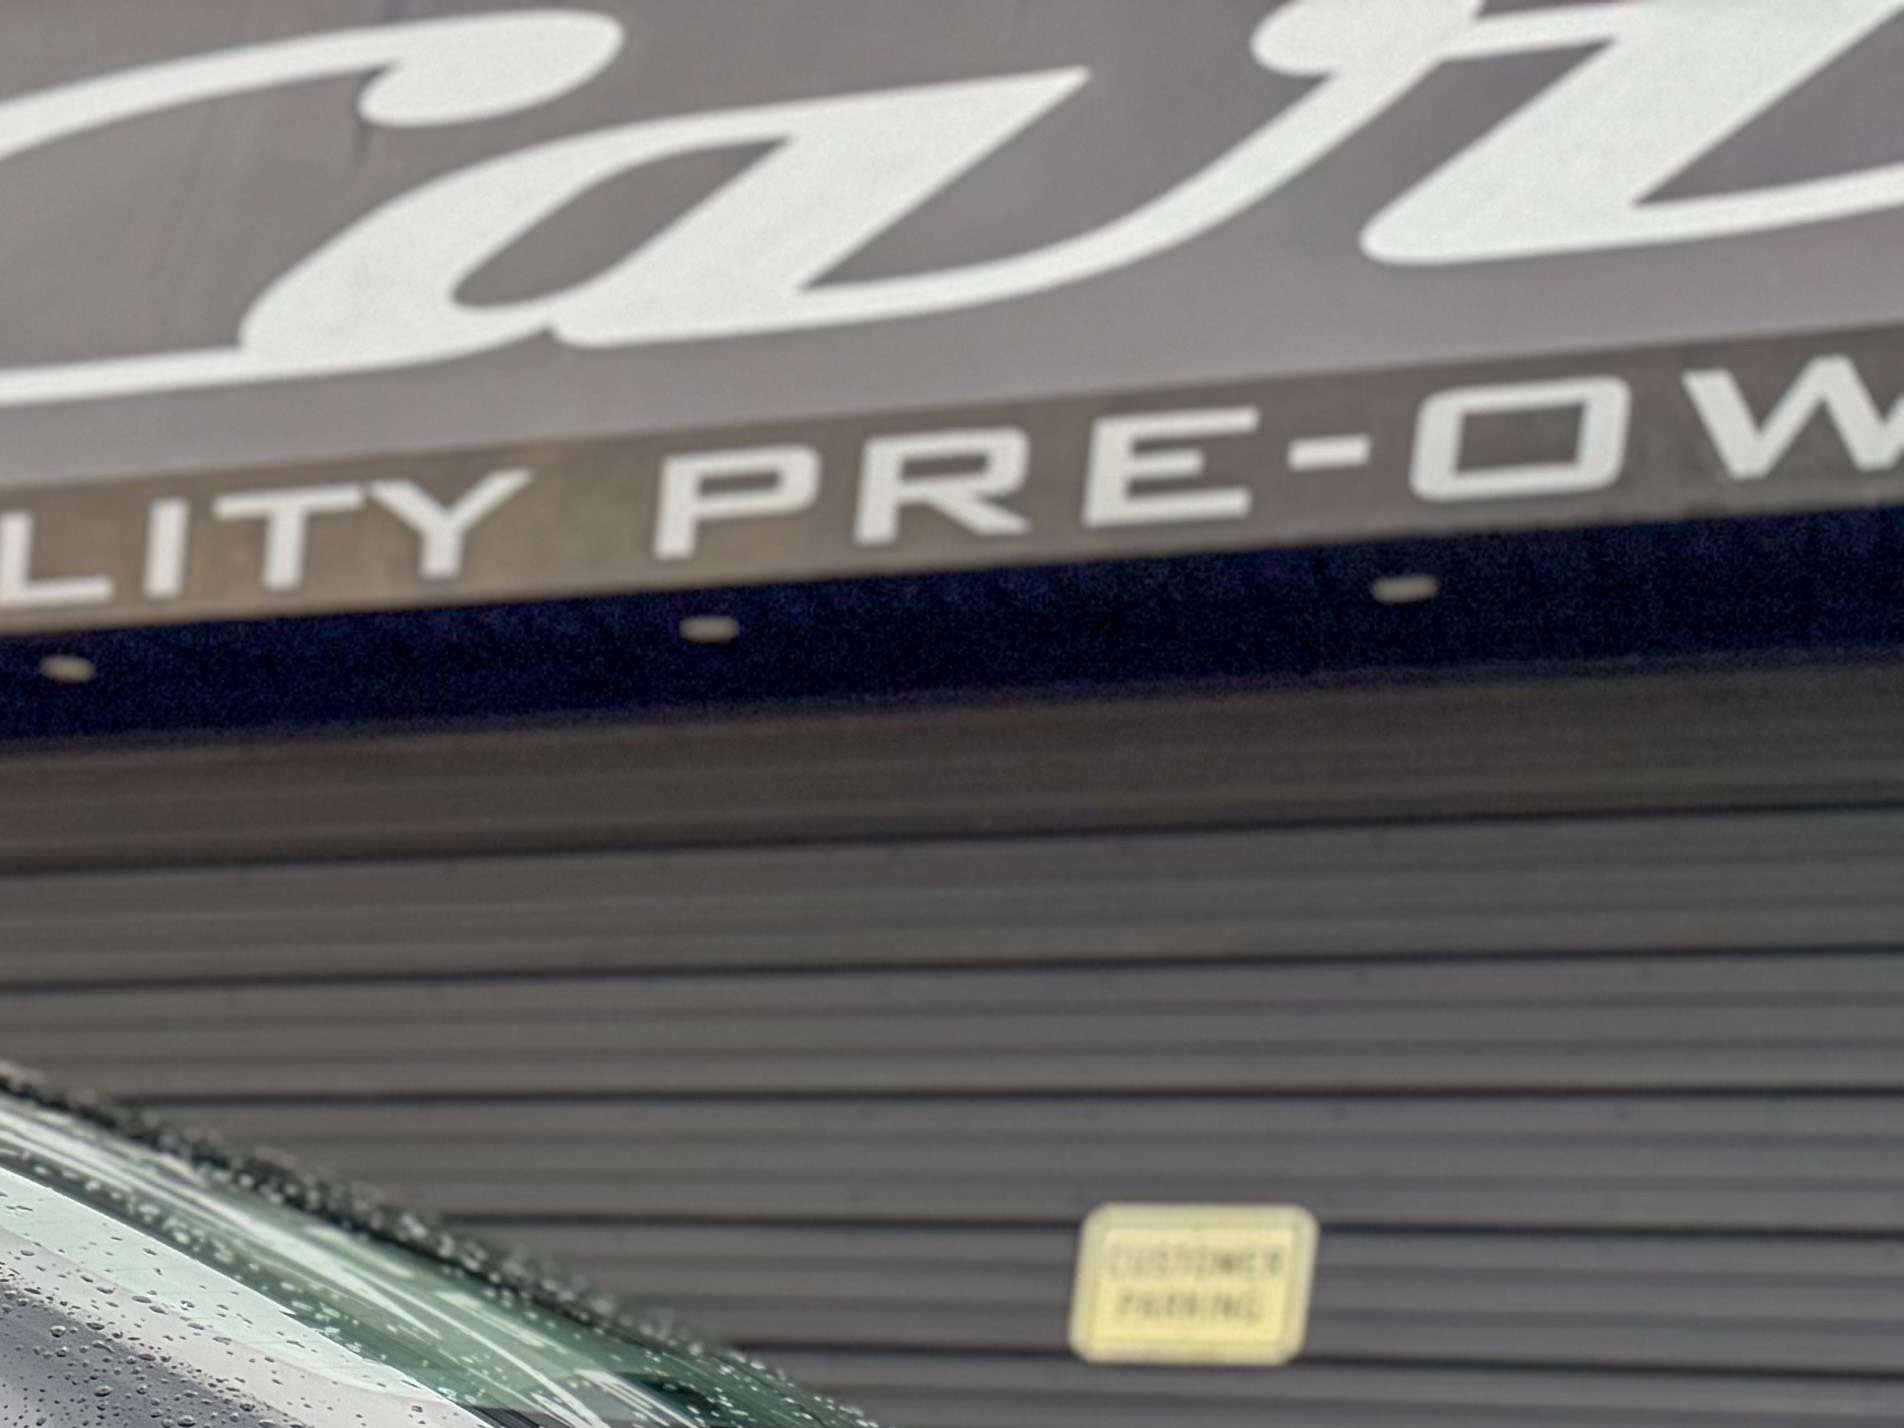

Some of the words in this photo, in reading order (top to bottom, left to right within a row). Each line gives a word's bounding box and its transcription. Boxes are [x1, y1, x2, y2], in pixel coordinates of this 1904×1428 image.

[654, 355, 1904, 561] PRE-OW
[1105, 1246, 1284, 1278] CUSTOMER
[1113, 1291, 1264, 1322] PARKING
